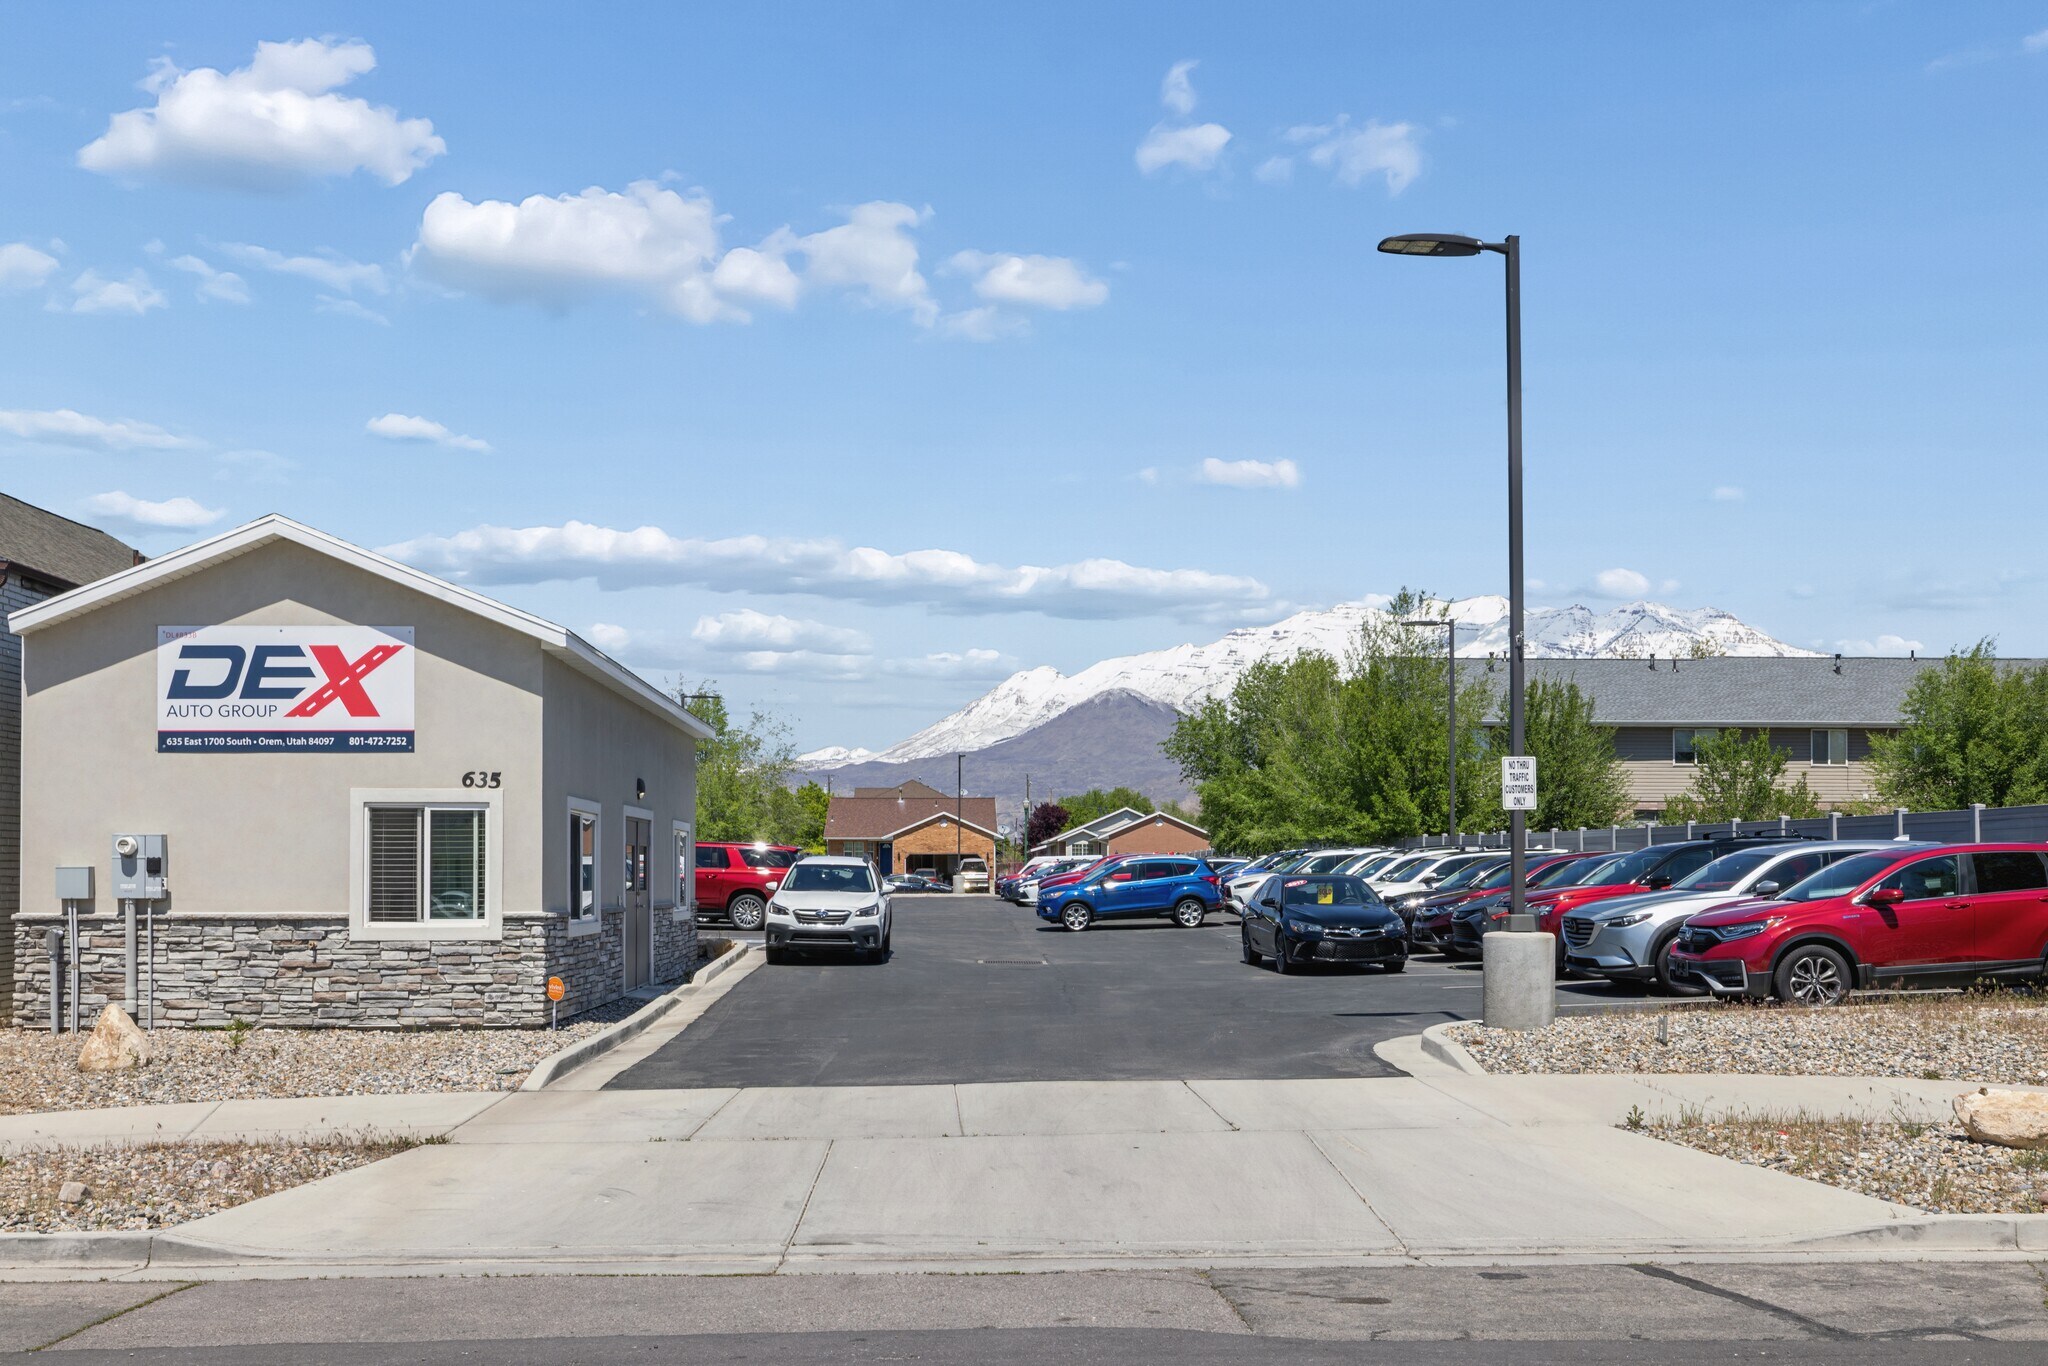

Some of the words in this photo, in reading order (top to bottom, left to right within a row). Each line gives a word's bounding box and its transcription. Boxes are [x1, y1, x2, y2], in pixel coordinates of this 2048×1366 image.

[166, 645, 406, 717] DEX
[166, 704, 213, 718] AUTO
[218, 704, 278, 718] GROUP
[166, 737, 183, 746] 635
[184, 737, 202, 746] East
[204, 737, 225, 746] 1700
[226, 737, 252, 746] South
[258, 737, 285, 747] Orem,
[286, 737, 306, 746] Utah
[308, 737, 335, 746] 84097
[349, 737, 407, 746] 801-472-7252
[1508, 760, 1516, 770] NO
[1516, 760, 1530, 770] THRU
[461, 771, 502, 789] 635
[1510, 772, 1529, 782] TRAFFIC
[1505, 784, 1534, 794] CUSTOMERS
[1513, 796, 1526, 806] ONLY
